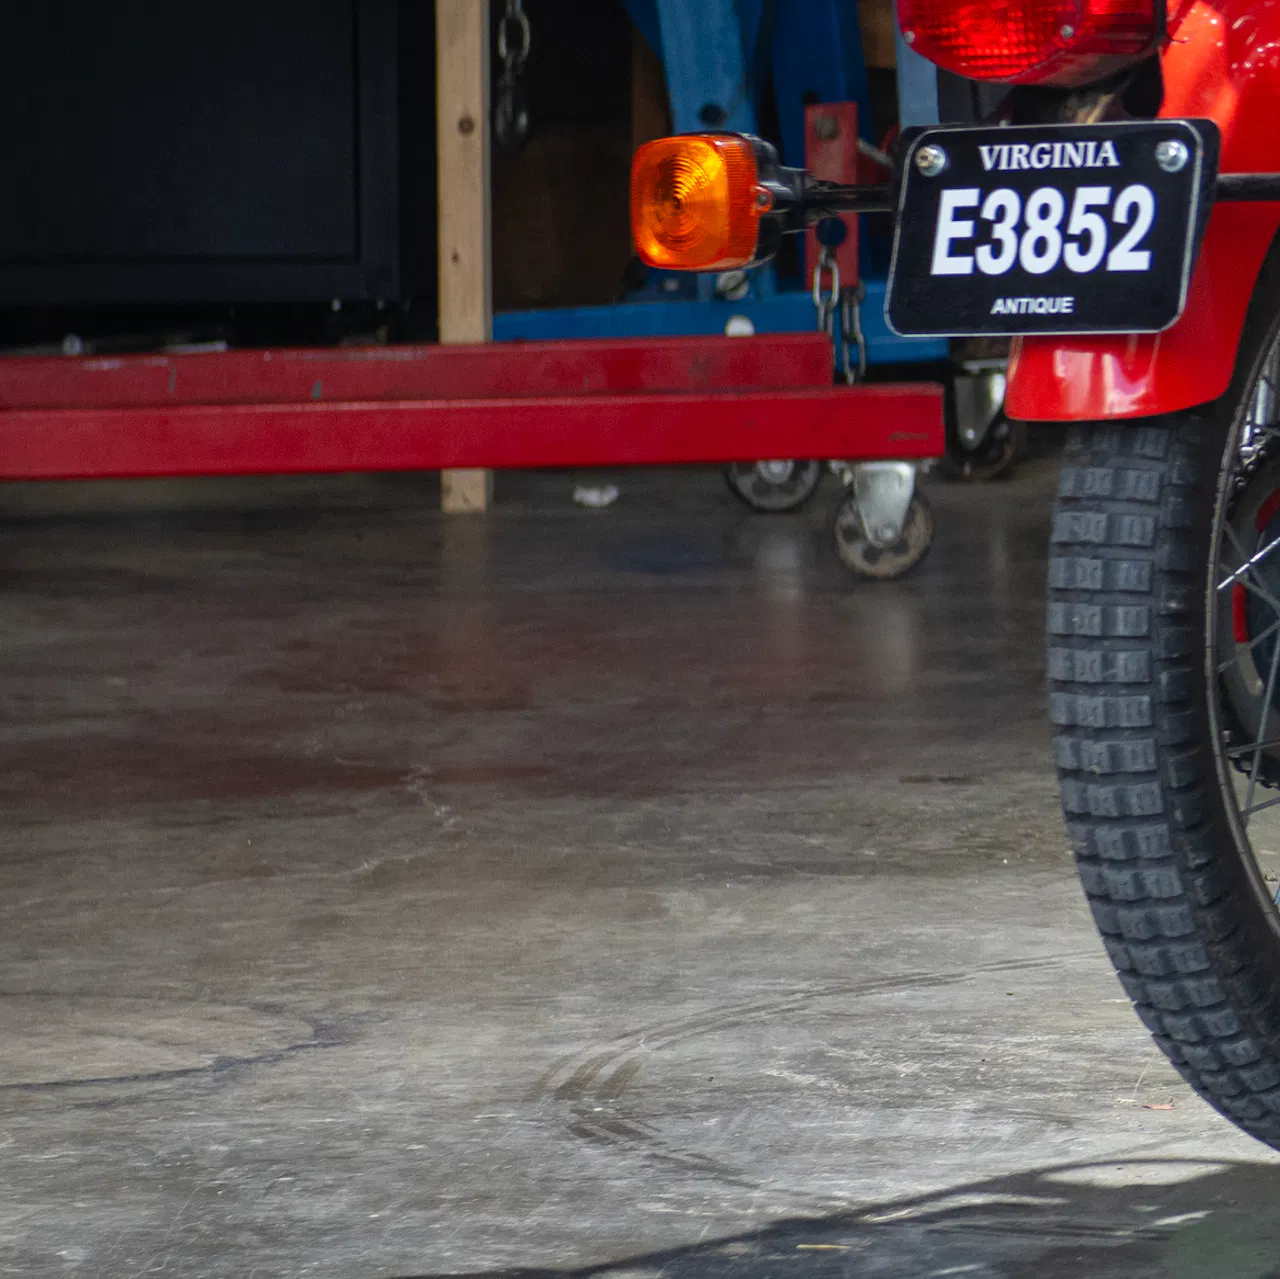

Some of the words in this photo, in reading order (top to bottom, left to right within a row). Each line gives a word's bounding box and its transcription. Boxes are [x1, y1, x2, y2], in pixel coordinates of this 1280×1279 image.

[978, 140, 1121, 171] VIRGINIA
[930, 184, 1156, 275] E3852
[989, 296, 1076, 315] ANTIQUE
